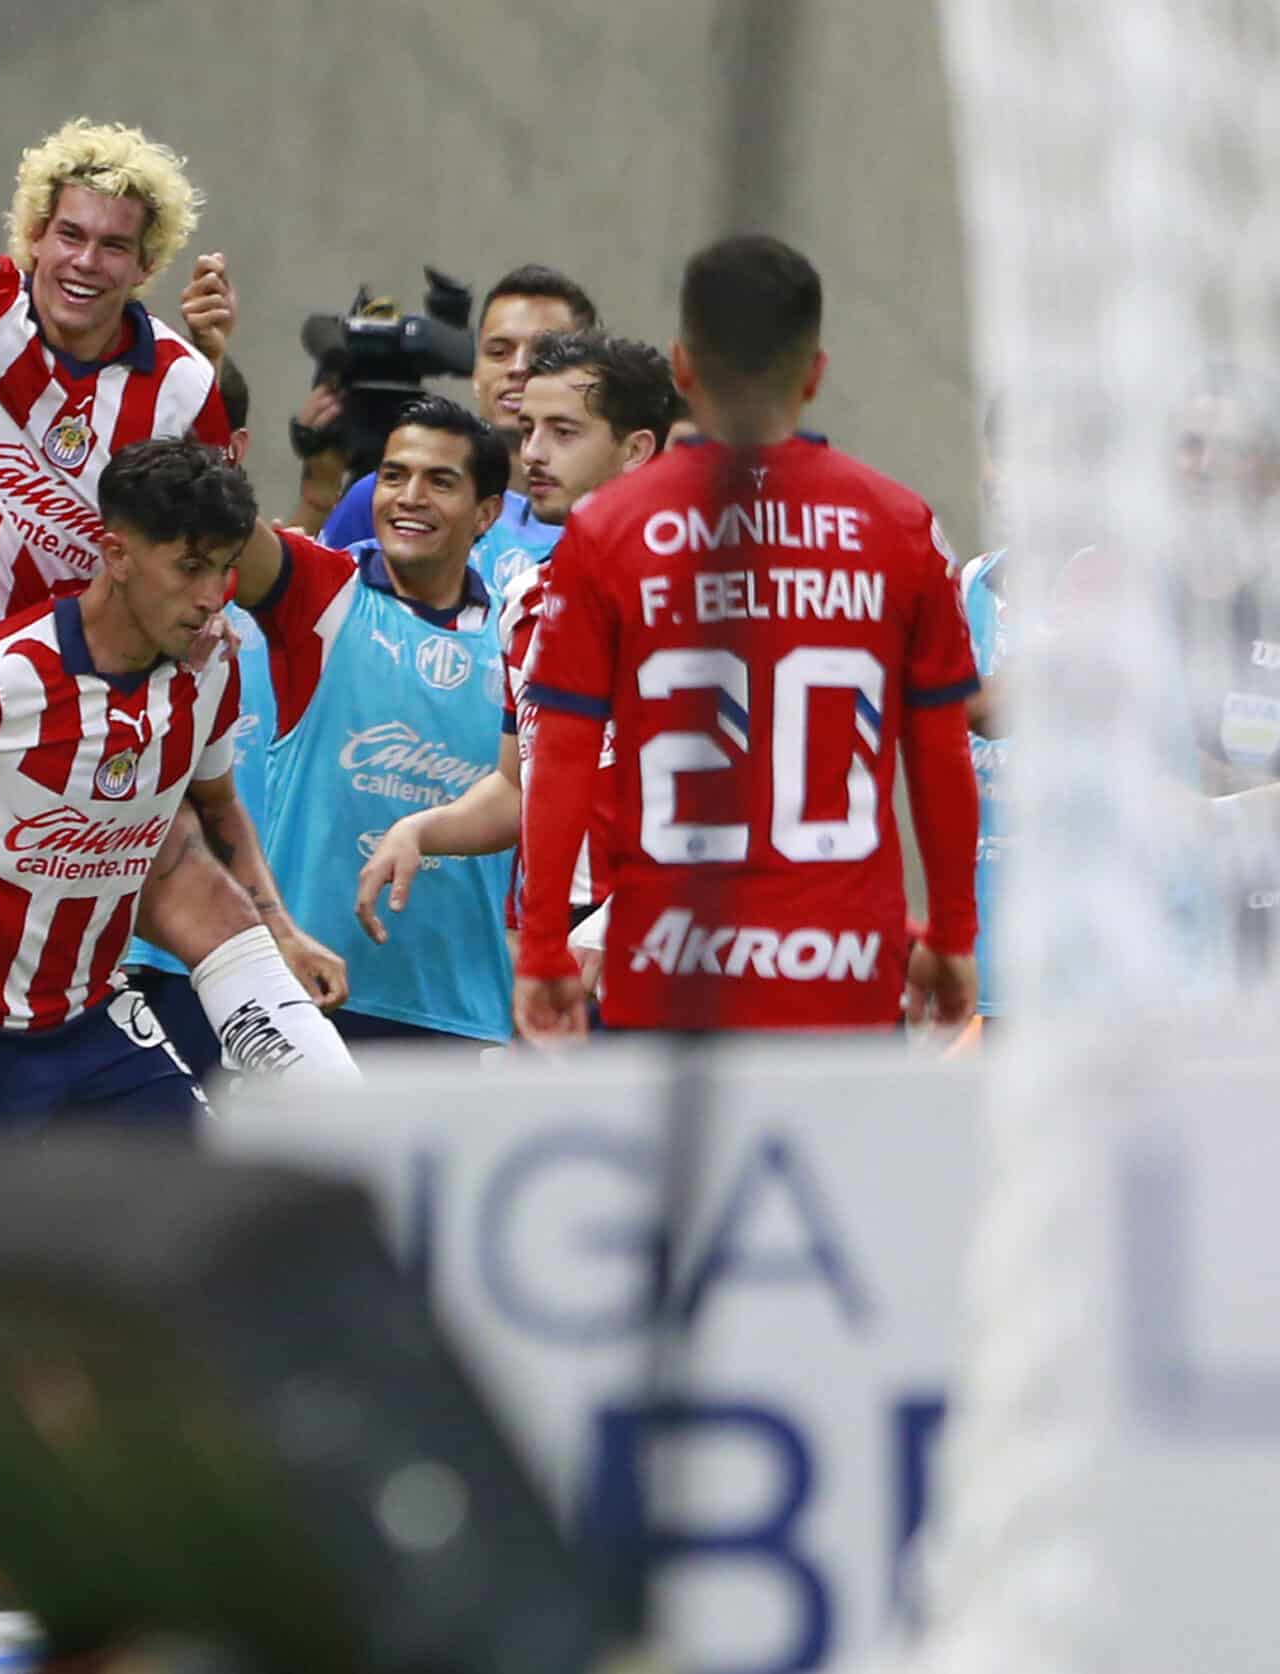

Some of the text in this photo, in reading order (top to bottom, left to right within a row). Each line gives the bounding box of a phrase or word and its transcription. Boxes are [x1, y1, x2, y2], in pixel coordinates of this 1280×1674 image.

[643, 500, 863, 555] OMNILIFE
[639, 567, 885, 627] F. BELTRAN
[417, 635, 471, 689] MG
[636, 646, 886, 864] 20
[5, 804, 170, 855] Caliente
[16, 855, 153, 880] caliente.m
[631, 908, 881, 981] AKRON
